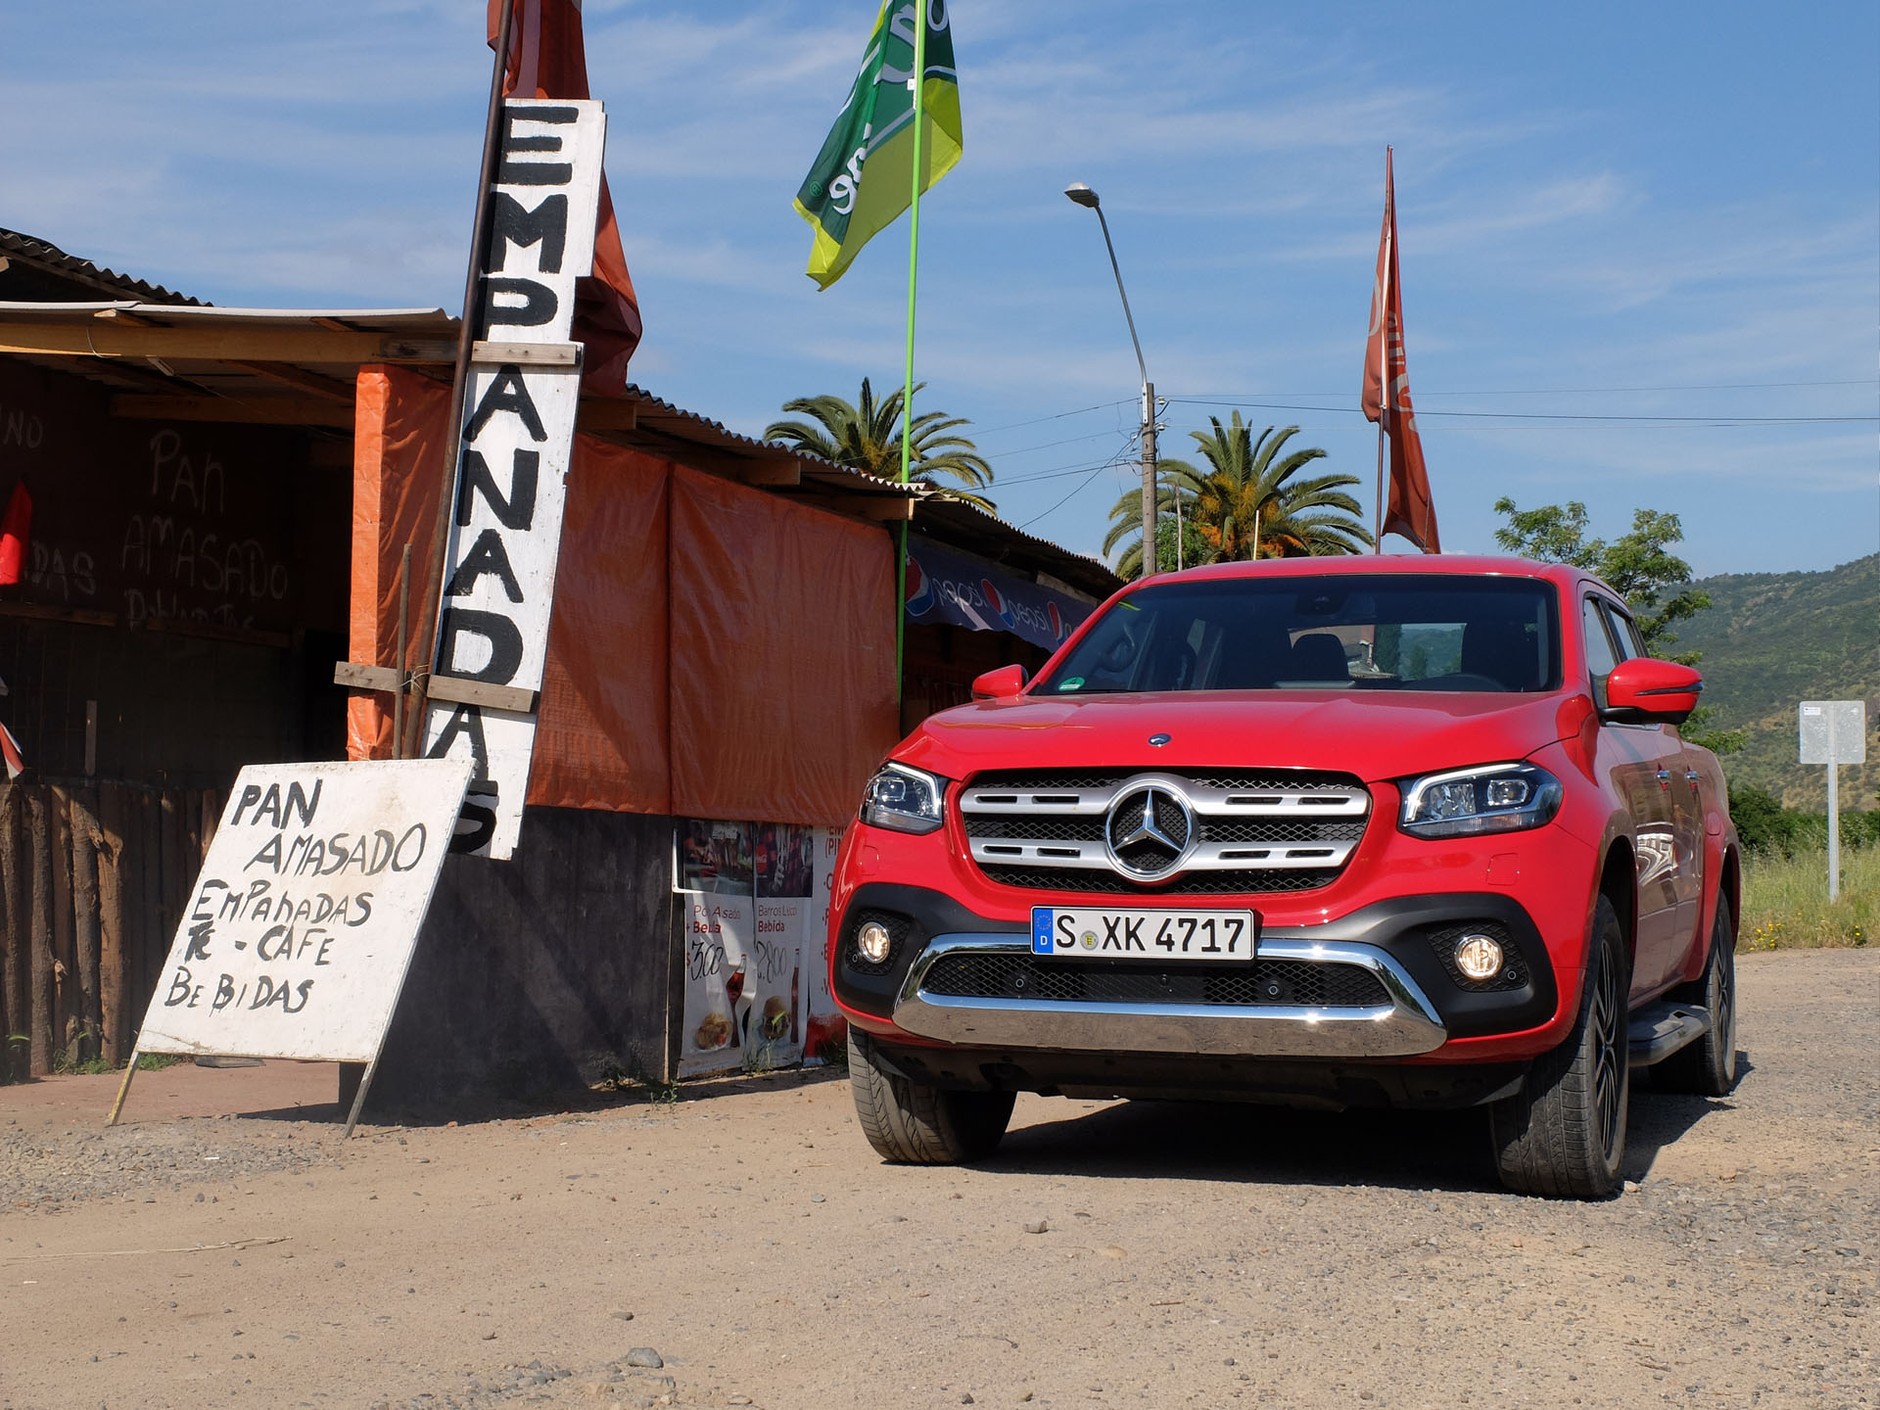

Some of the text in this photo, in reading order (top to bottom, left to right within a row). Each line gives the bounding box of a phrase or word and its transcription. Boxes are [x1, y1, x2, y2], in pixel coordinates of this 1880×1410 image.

[932, 577, 988, 607] pepsi
[1007, 598, 1050, 632] pepsi
[231, 778, 323, 829] PAN
[243, 822, 427, 877] AMASADO
[256, 924, 335, 966] CAFE
[758, 919, 785, 933] Bebida
[1056, 914, 1076, 949] S
[1102, 915, 1146, 951] XK
[1155, 917, 1244, 953] 4717
